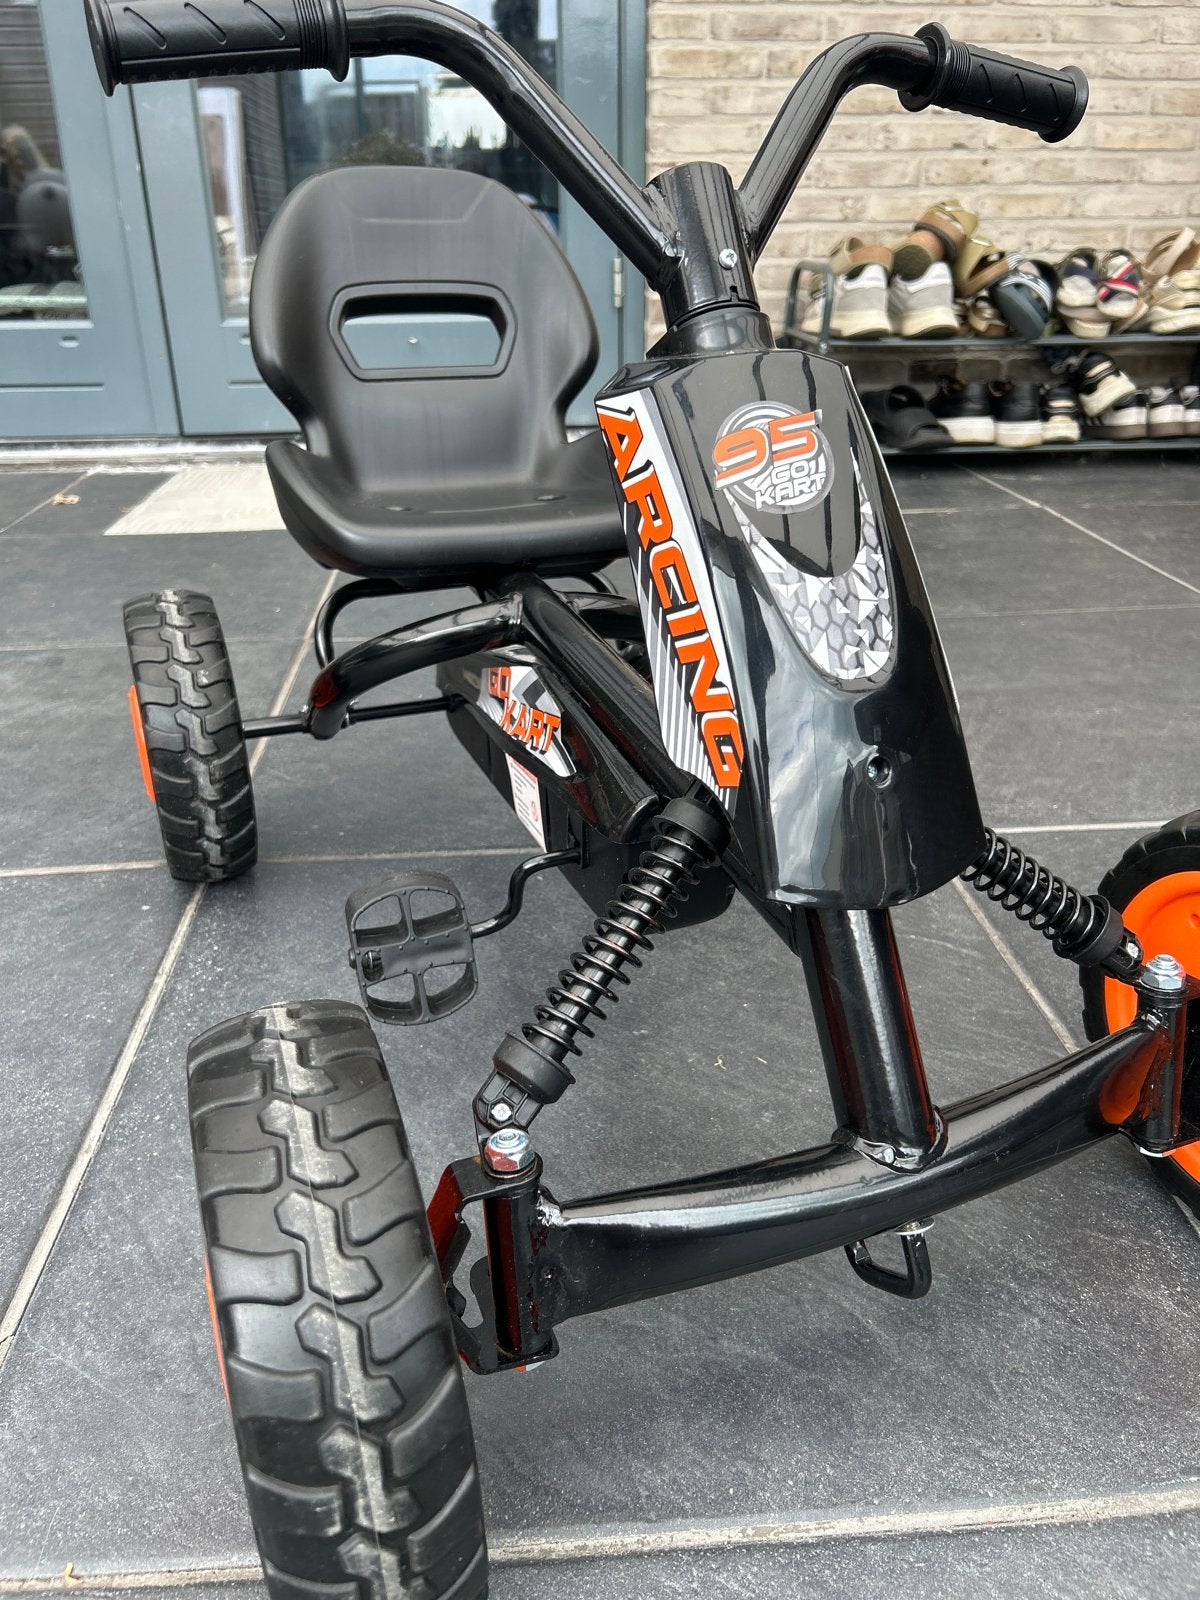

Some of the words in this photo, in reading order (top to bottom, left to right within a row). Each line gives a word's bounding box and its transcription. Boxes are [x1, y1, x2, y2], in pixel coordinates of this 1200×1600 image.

[713, 410, 819, 489] 95
[771, 459, 810, 485] GO
[755, 472, 826, 509] KART
[597, 408, 745, 788] ARCING
[489, 665, 511, 700] GO
[499, 698, 561, 754] KART
